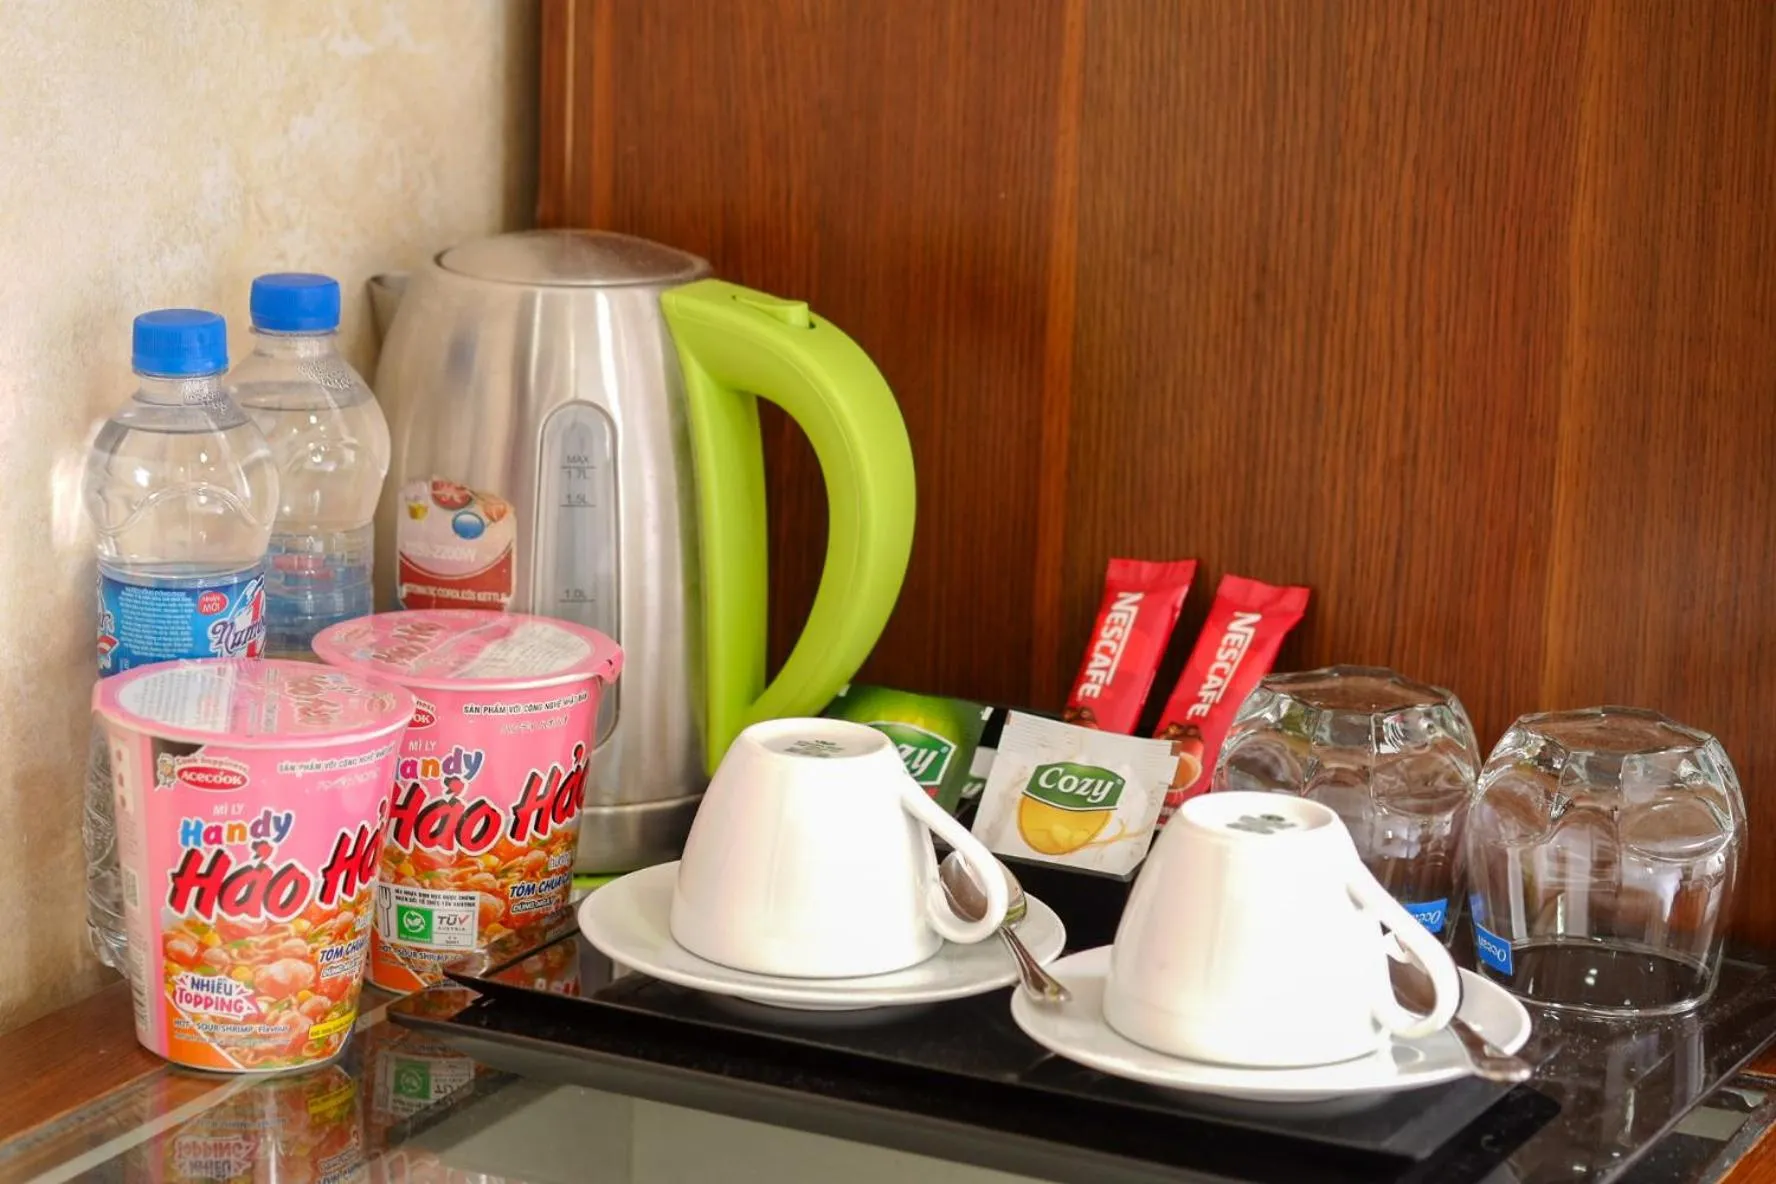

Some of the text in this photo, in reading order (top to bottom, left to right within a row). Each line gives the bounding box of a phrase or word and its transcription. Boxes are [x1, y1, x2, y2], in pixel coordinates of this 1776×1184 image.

[566, 454, 590, 465] MAX
[397, 746, 483, 781] andy
[899, 743, 939, 778] zy
[1037, 765, 1115, 803] Cozy
[180, 808, 293, 848] Handy
